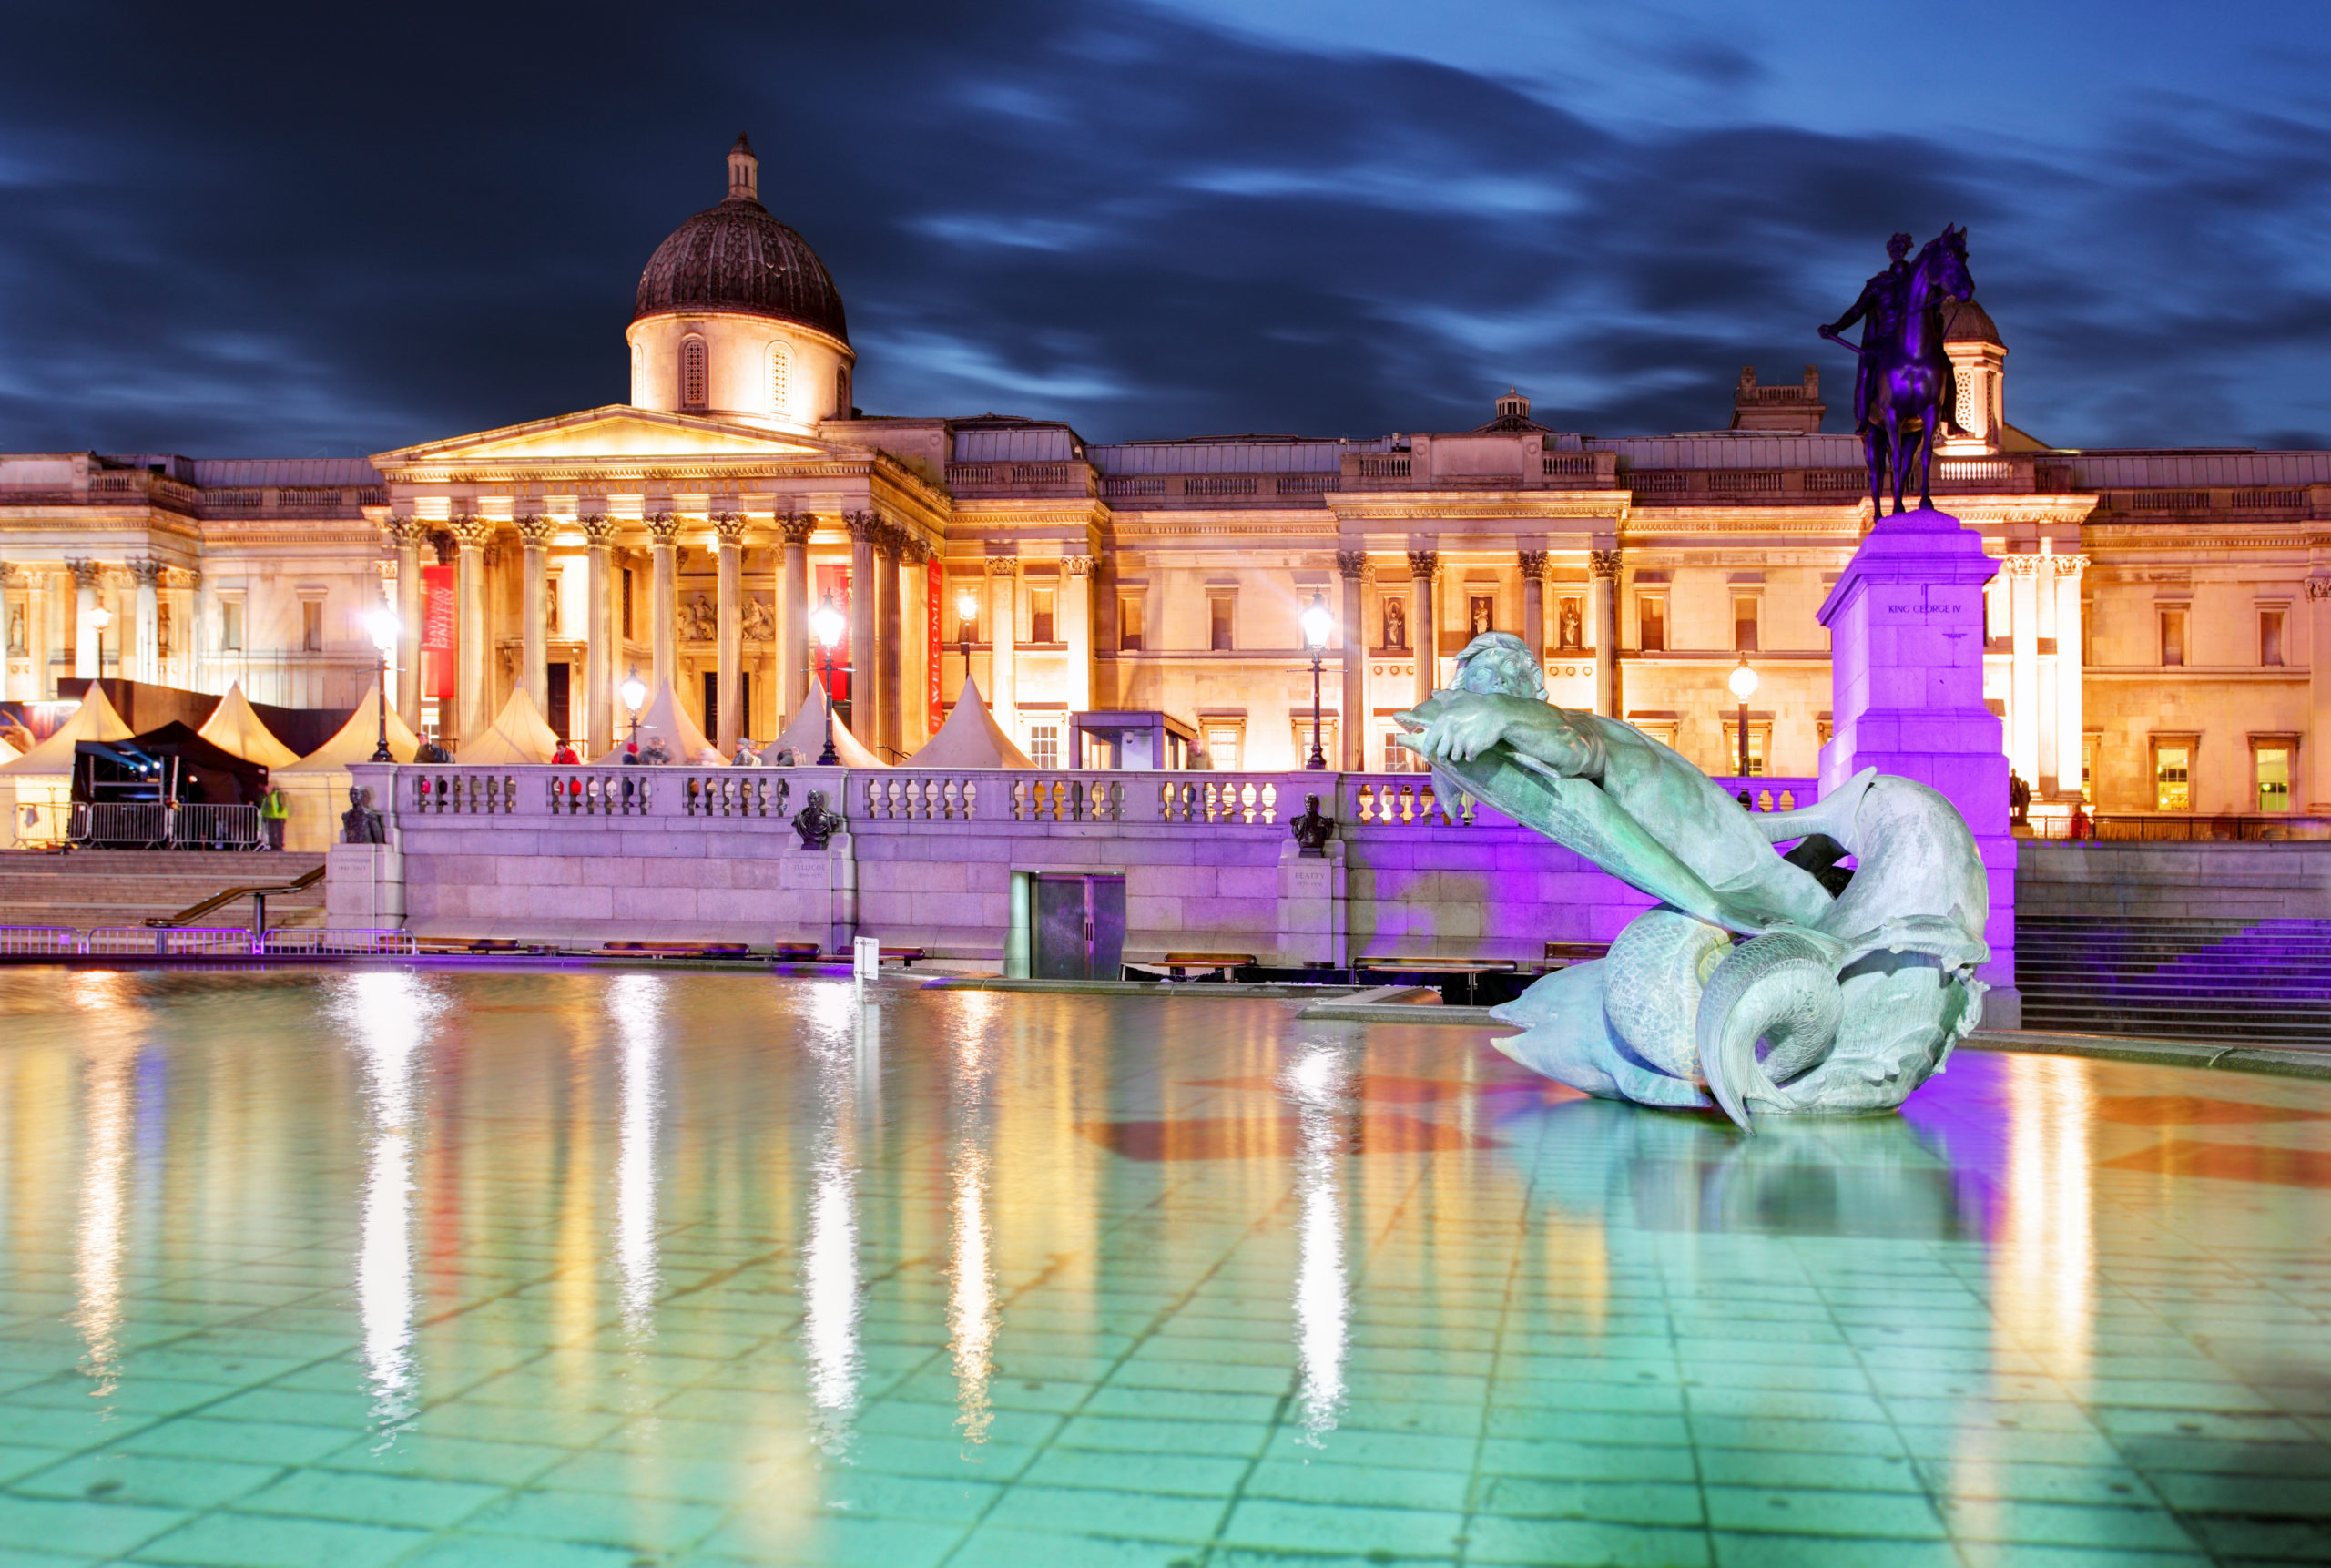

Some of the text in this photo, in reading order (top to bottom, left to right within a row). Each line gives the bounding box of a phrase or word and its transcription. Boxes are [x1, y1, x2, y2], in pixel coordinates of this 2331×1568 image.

[545, 481, 649, 495] NATIONAL
[667, 479, 764, 494] GALLERY
[1888, 605, 1961, 613] KING GEORGE IV
